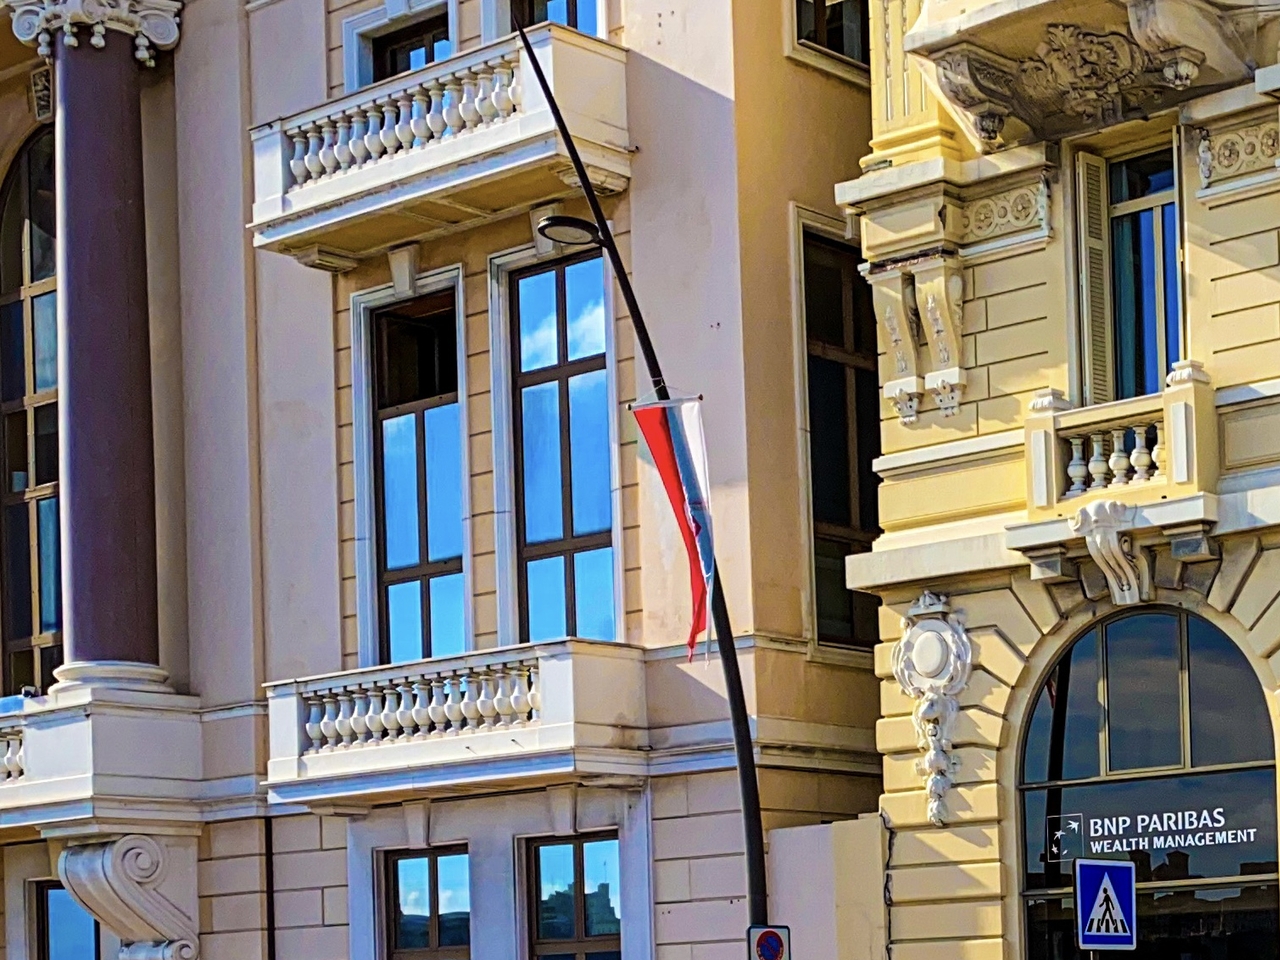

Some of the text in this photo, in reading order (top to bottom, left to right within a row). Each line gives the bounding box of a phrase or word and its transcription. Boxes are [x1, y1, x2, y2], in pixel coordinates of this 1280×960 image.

[1090, 808, 1225, 837] BNP PARIBAS
[1090, 828, 1257, 853] WEALTH MANAGEMENT
